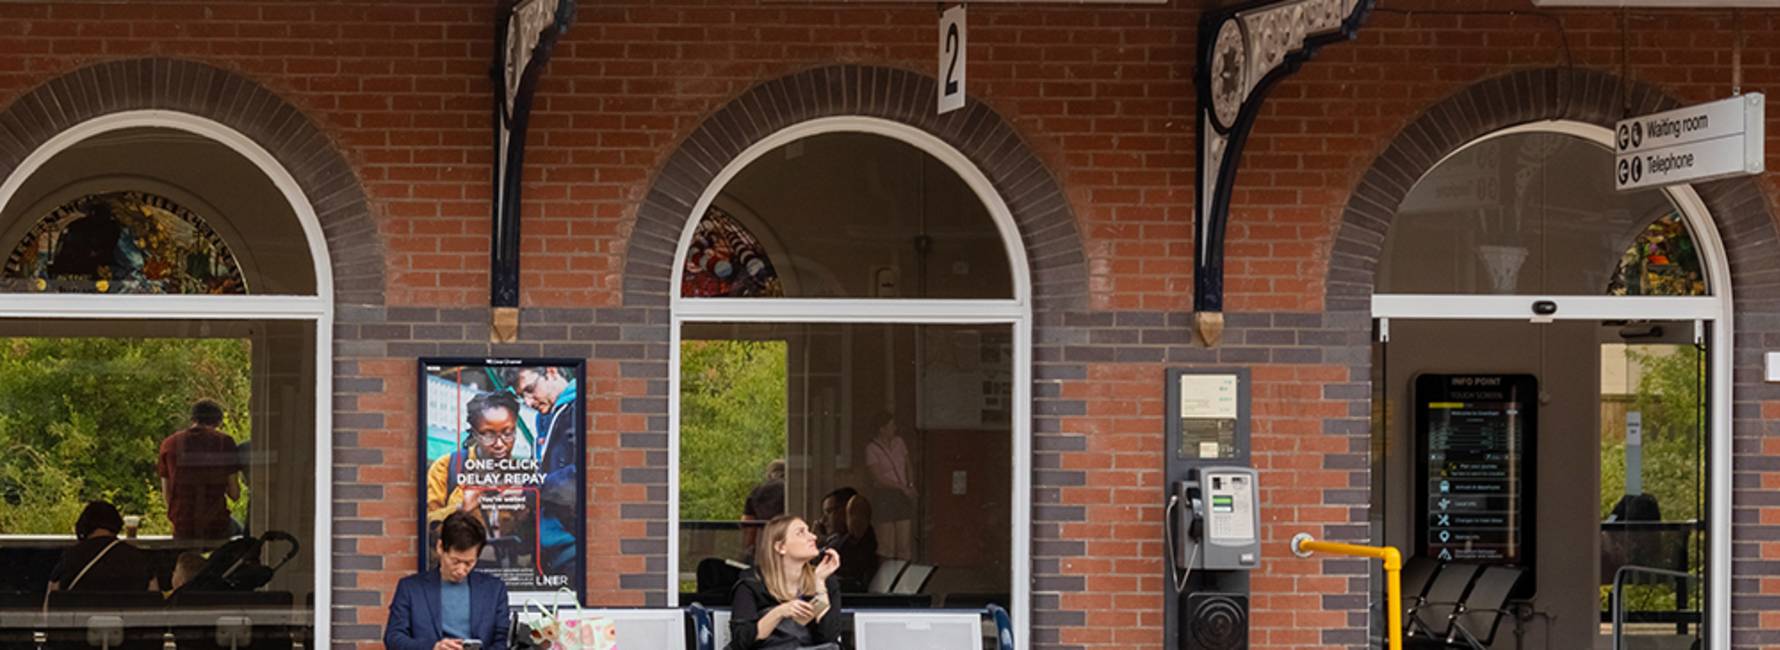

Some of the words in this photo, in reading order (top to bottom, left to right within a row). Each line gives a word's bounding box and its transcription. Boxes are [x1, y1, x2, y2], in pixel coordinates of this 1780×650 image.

[945, 22, 959, 97] 2
[1646, 118, 1682, 139] Waiting
[1682, 114, 1709, 132] room
[1646, 152, 1694, 175] Telephone
[1451, 377, 1473, 386] INFO
[1474, 377, 1502, 386] POINT
[1450, 391, 1474, 399] TOUCH
[464, 458, 540, 470] ONE-CLICK
[456, 473, 501, 485] DELAY
[503, 473, 548, 485] REPAY
[535, 574, 569, 587] LNER
